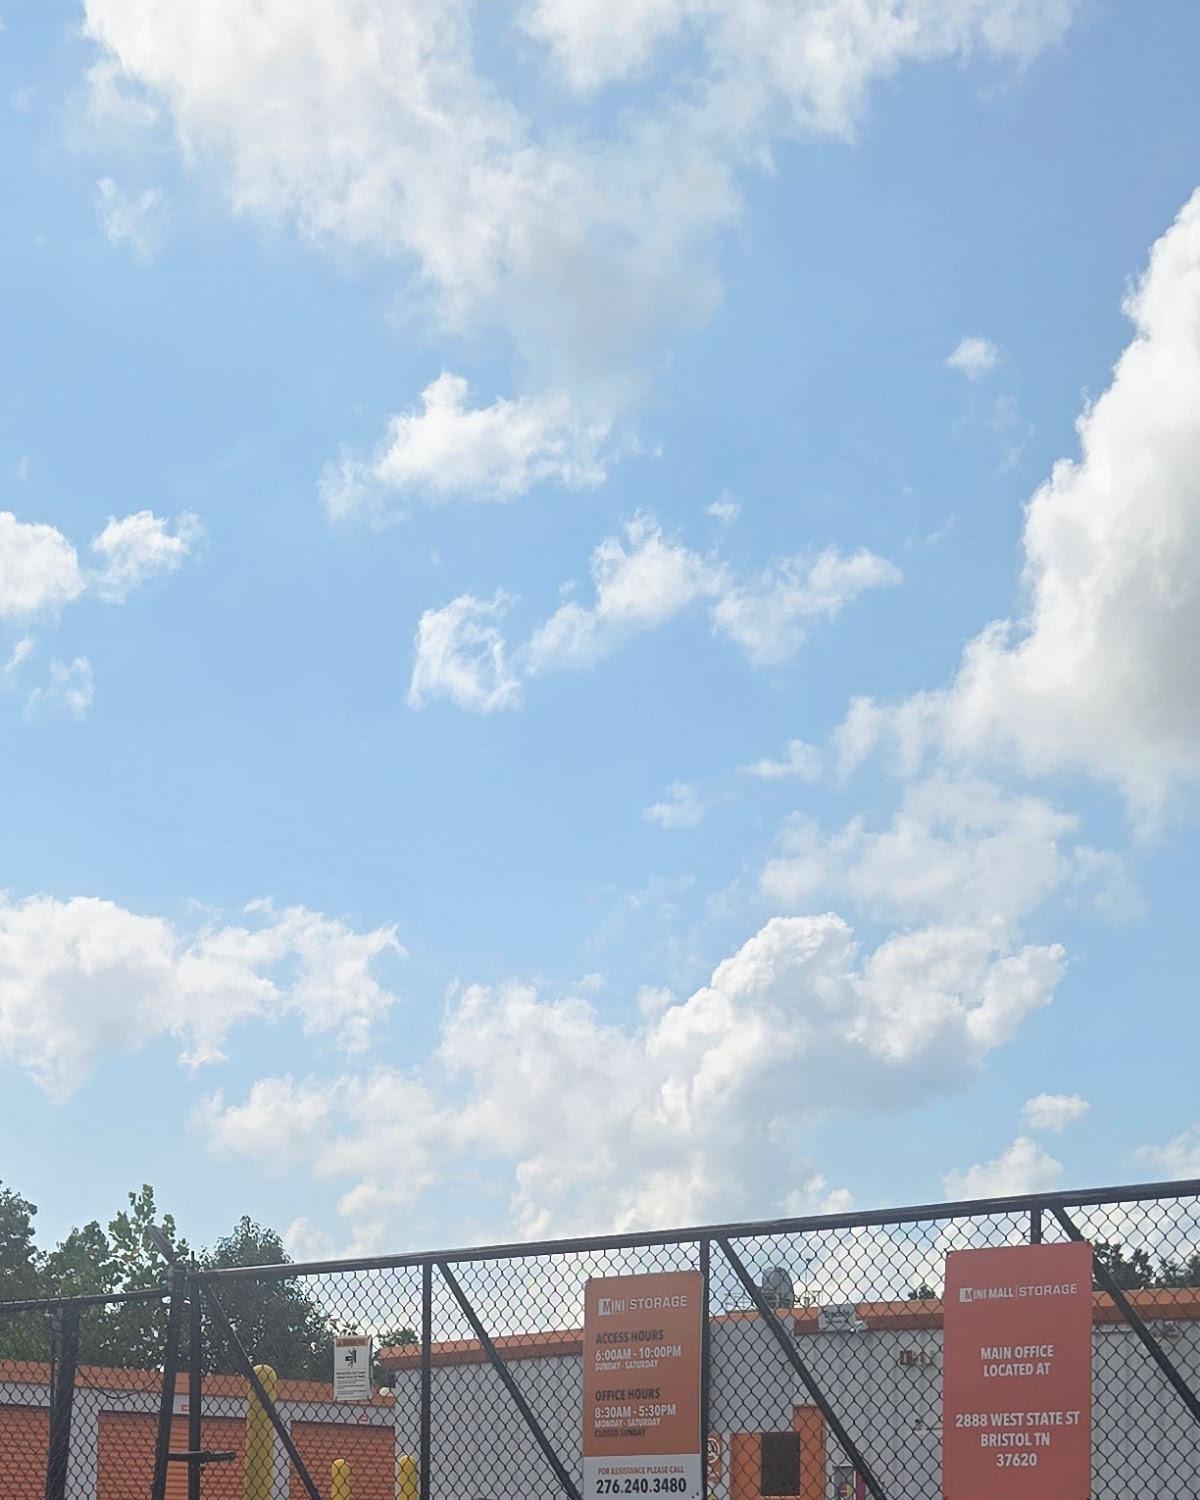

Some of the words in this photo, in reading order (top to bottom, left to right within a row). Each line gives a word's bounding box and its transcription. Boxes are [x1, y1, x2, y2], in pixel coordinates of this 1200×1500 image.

[988, 1287, 1014, 1299] MALL
[1018, 1284, 1078, 1297] STORAGE
[598, 1298, 625, 1315] MINI
[629, 1295, 688, 1310] STORAGE
[595, 1331, 629, 1344] ACCESS
[631, 1329, 664, 1342] HOURS
[595, 1348, 631, 1362] 6:00AM
[639, 1345, 682, 1359] 10:00PM
[981, 1347, 1012, 1360] MAIN
[1014, 1344, 1054, 1358] OFFICE
[595, 1362, 621, 1371] SUNDAY
[625, 1359, 659, 1369] SATURDAY
[983, 1363, 1033, 1377] LOCATED
[1036, 1362, 1051, 1375] AT
[595, 1390, 626, 1401] OFFICE
[628, 1387, 661, 1400] HOURS
[595, 1405, 632, 1419] 8:30AM
[638, 1404, 677, 1417] 5:30PM
[955, 1413, 988, 1427] 2888
[990, 1412, 1024, 1426] WEST
[1026, 1411, 1063, 1426] STATE
[1065, 1411, 1080, 1424] ST
[595, 1419, 623, 1428] MONDAY
[627, 1417, 661, 1427] SATURDAY
[981, 1432, 1032, 1447] BRISTOL
[1033, 1432, 1050, 1446] TN
[996, 1453, 1038, 1467] 37620
[598, 1467, 610, 1475] FOR
[611, 1466, 645, 1475] ASSISTANCE
[647, 1465, 668, 1474] PLEASE
[669, 1465, 685, 1473] CALL
[595, 1477, 687, 1494] 276.240.3480
